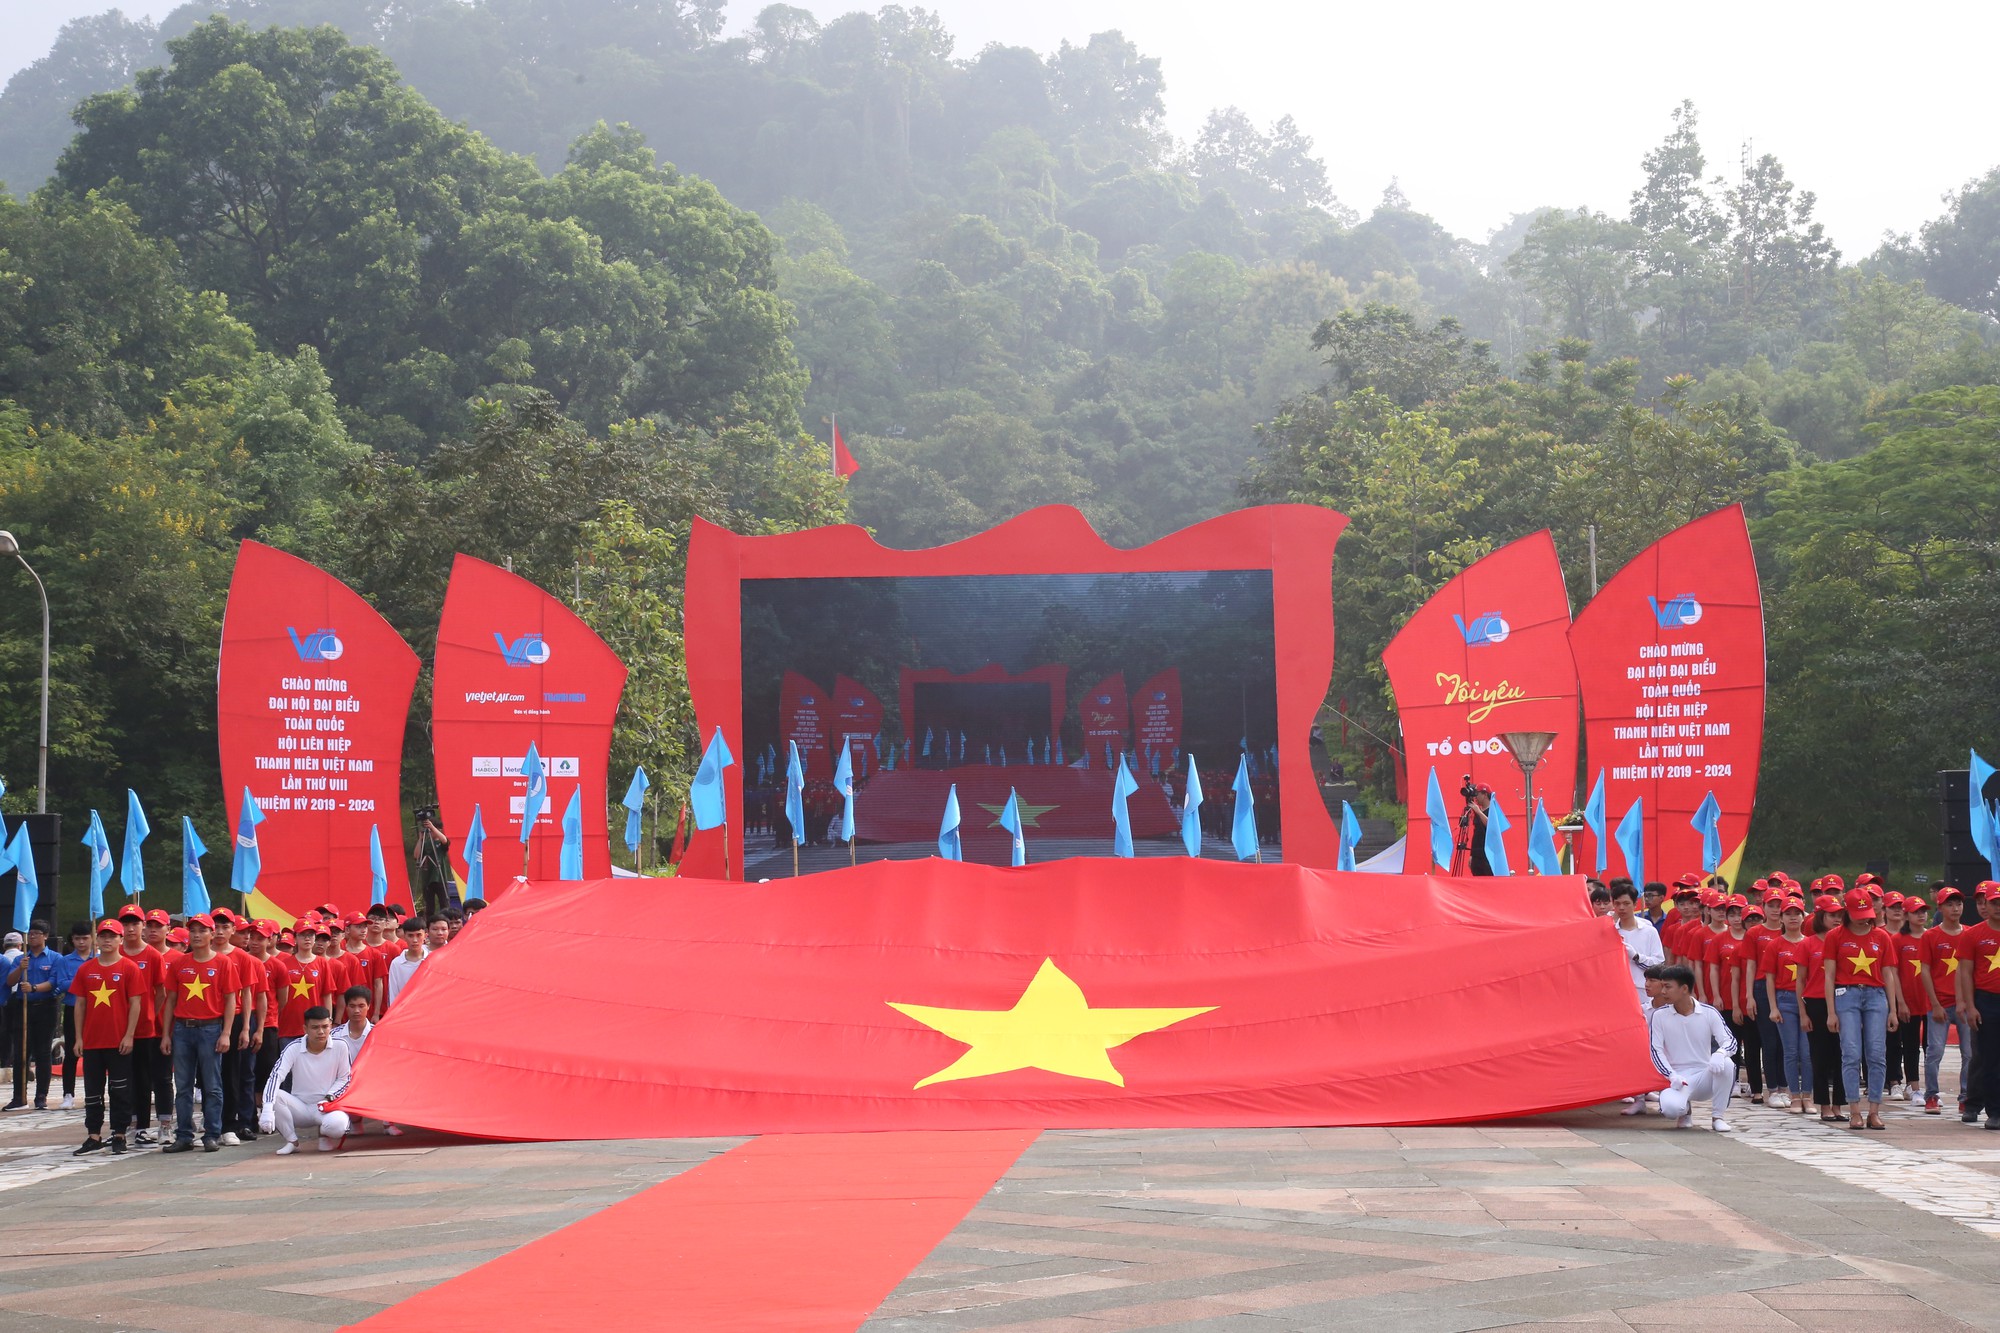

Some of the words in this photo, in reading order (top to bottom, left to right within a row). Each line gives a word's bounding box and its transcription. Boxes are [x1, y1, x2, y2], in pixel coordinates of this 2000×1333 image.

[1640, 643, 1667, 658] CHÀO
[1671, 642, 1703, 656] MỪNG
[1627, 666, 1645, 681] ĐẠI
[1649, 663, 1666, 679] HỘI
[1670, 664, 1688, 681] ĐẠI
[1692, 658, 1716, 675] BIỂU
[282, 676, 311, 690] CHÀO
[314, 677, 347, 692] MỪNG
[1642, 683, 1668, 698] TOÀN
[1672, 680, 1701, 696] QUỐC
[268, 697, 287, 712] ĐẠI
[291, 696, 309, 712] HỘI
[313, 698, 332, 714] ĐẠI
[335, 696, 360, 712] BIỂU
[1636, 704, 1653, 720] HỘI
[1658, 703, 1679, 717] LIÊN
[1683, 702, 1708, 718] HIỆP
[285, 716, 312, 730] TOÀN
[315, 715, 345, 731] QUỐC
[1614, 727, 1647, 739] THANH
[1651, 724, 1675, 738] NIÊN
[1679, 723, 1701, 740] VIỆT
[1705, 723, 1730, 736] NAM
[278, 736, 296, 752] HỘI
[300, 736, 323, 750] LIÊN
[327, 737, 351, 752] HIỆP
[1426, 736, 1453, 756] TỔ
[1639, 742, 1658, 758] LẦN
[1662, 743, 1682, 757] THỨ
[1686, 745, 1704, 757] VIII
[255, 757, 290, 769] THANH
[294, 756, 319, 770] NIÊN
[322, 757, 345, 773] VIỆT
[348, 760, 373, 771] NAM
[1612, 765, 1647, 780] NHIỆM
[1651, 764, 1664, 778] KỲ
[1667, 766, 1691, 778] 2019
[1705, 764, 1732, 777] 2024
[282, 773, 301, 789] LẦN
[305, 776, 326, 790] THỨ
[329, 778, 347, 790] VIII
[294, 796, 307, 810] KỲ
[310, 798, 335, 810] 2019
[348, 799, 374, 811] 2024
